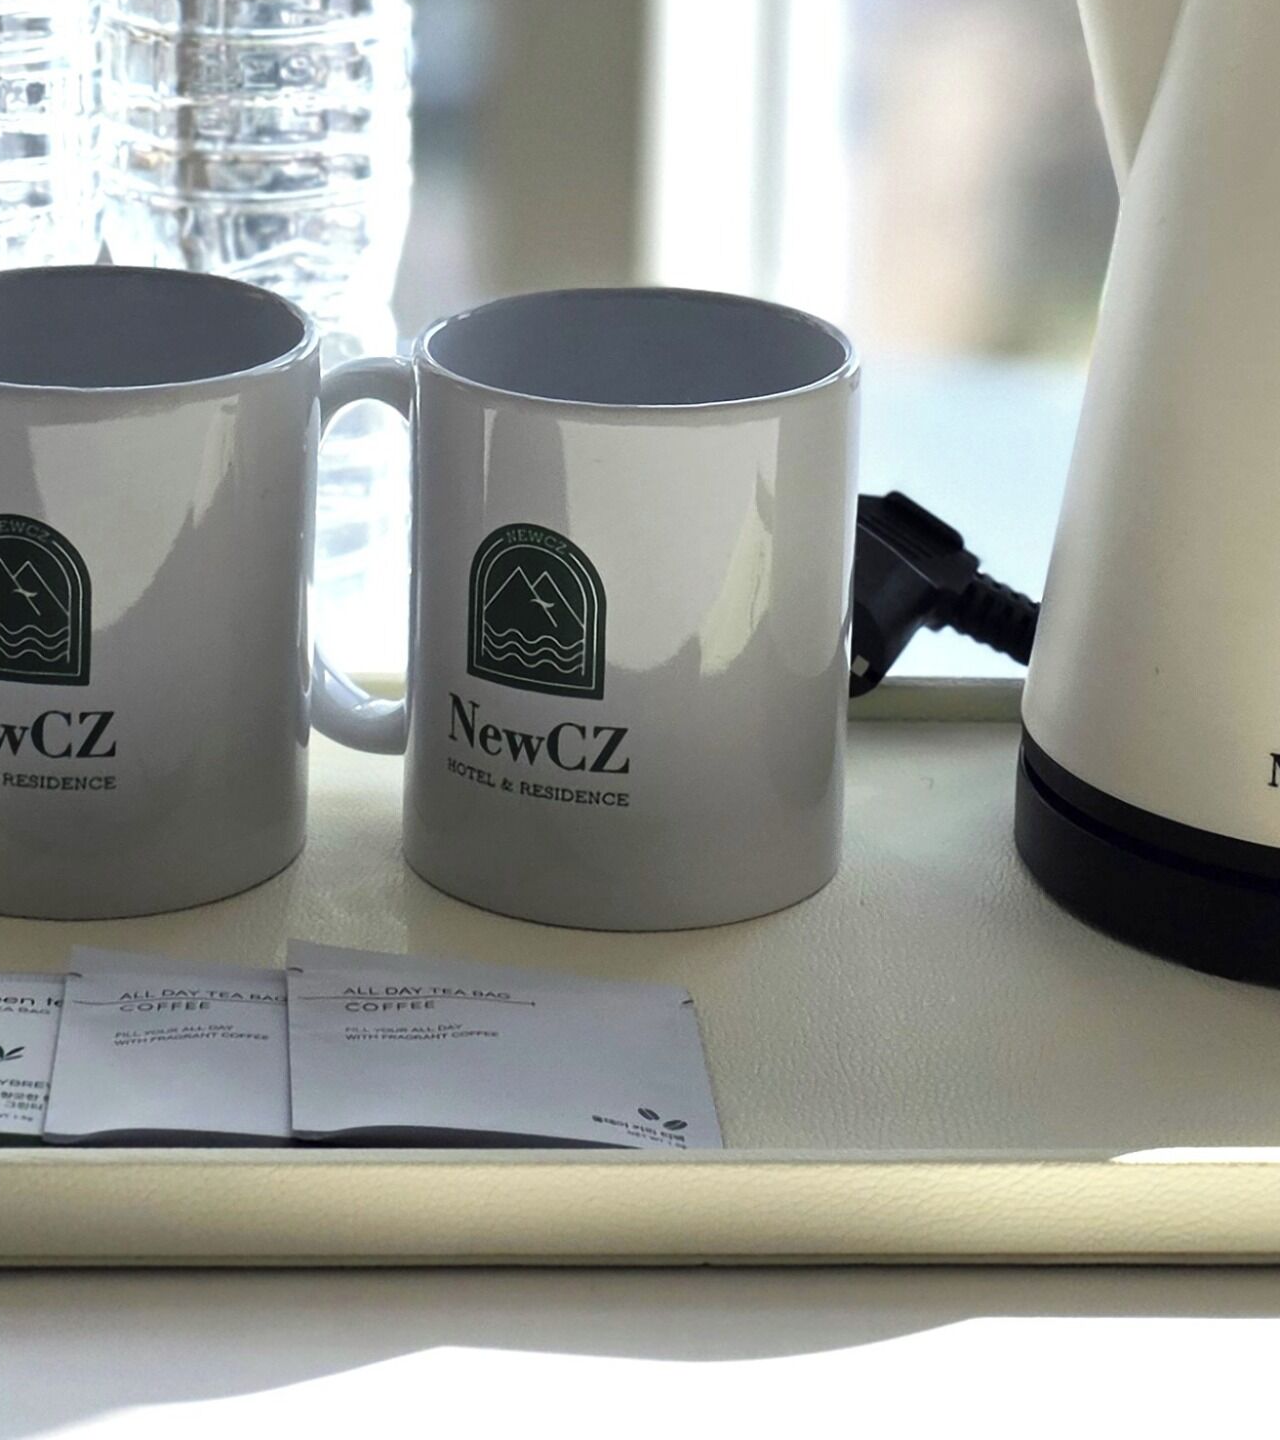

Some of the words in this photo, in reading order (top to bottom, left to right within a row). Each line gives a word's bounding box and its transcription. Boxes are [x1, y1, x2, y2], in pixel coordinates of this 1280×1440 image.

[506, 529, 568, 555] NEWCZ
[448, 692, 630, 774] NewCZ
[2, 772, 116, 791] RESIDENCE
[448, 758, 495, 788] HOTEL
[500, 778, 513, 792] &
[519, 781, 630, 807] RESIDENCE
[120, 991, 154, 1000] ALL
[162, 988, 200, 997] DAY
[207, 990, 243, 999] TEA
[343, 986, 380, 996] ALL
[384, 986, 423, 996] DAY
[430, 987, 467, 997] TEA
[472, 990, 511, 1000] BAG
[120, 1002, 211, 1012] COFFEE
[344, 1000, 436, 1012] COFFEE
[437, 1023, 463, 1032] DAY
[114, 1038, 147, 1046] WITH
[221, 1032, 269, 1040] COFFEE
